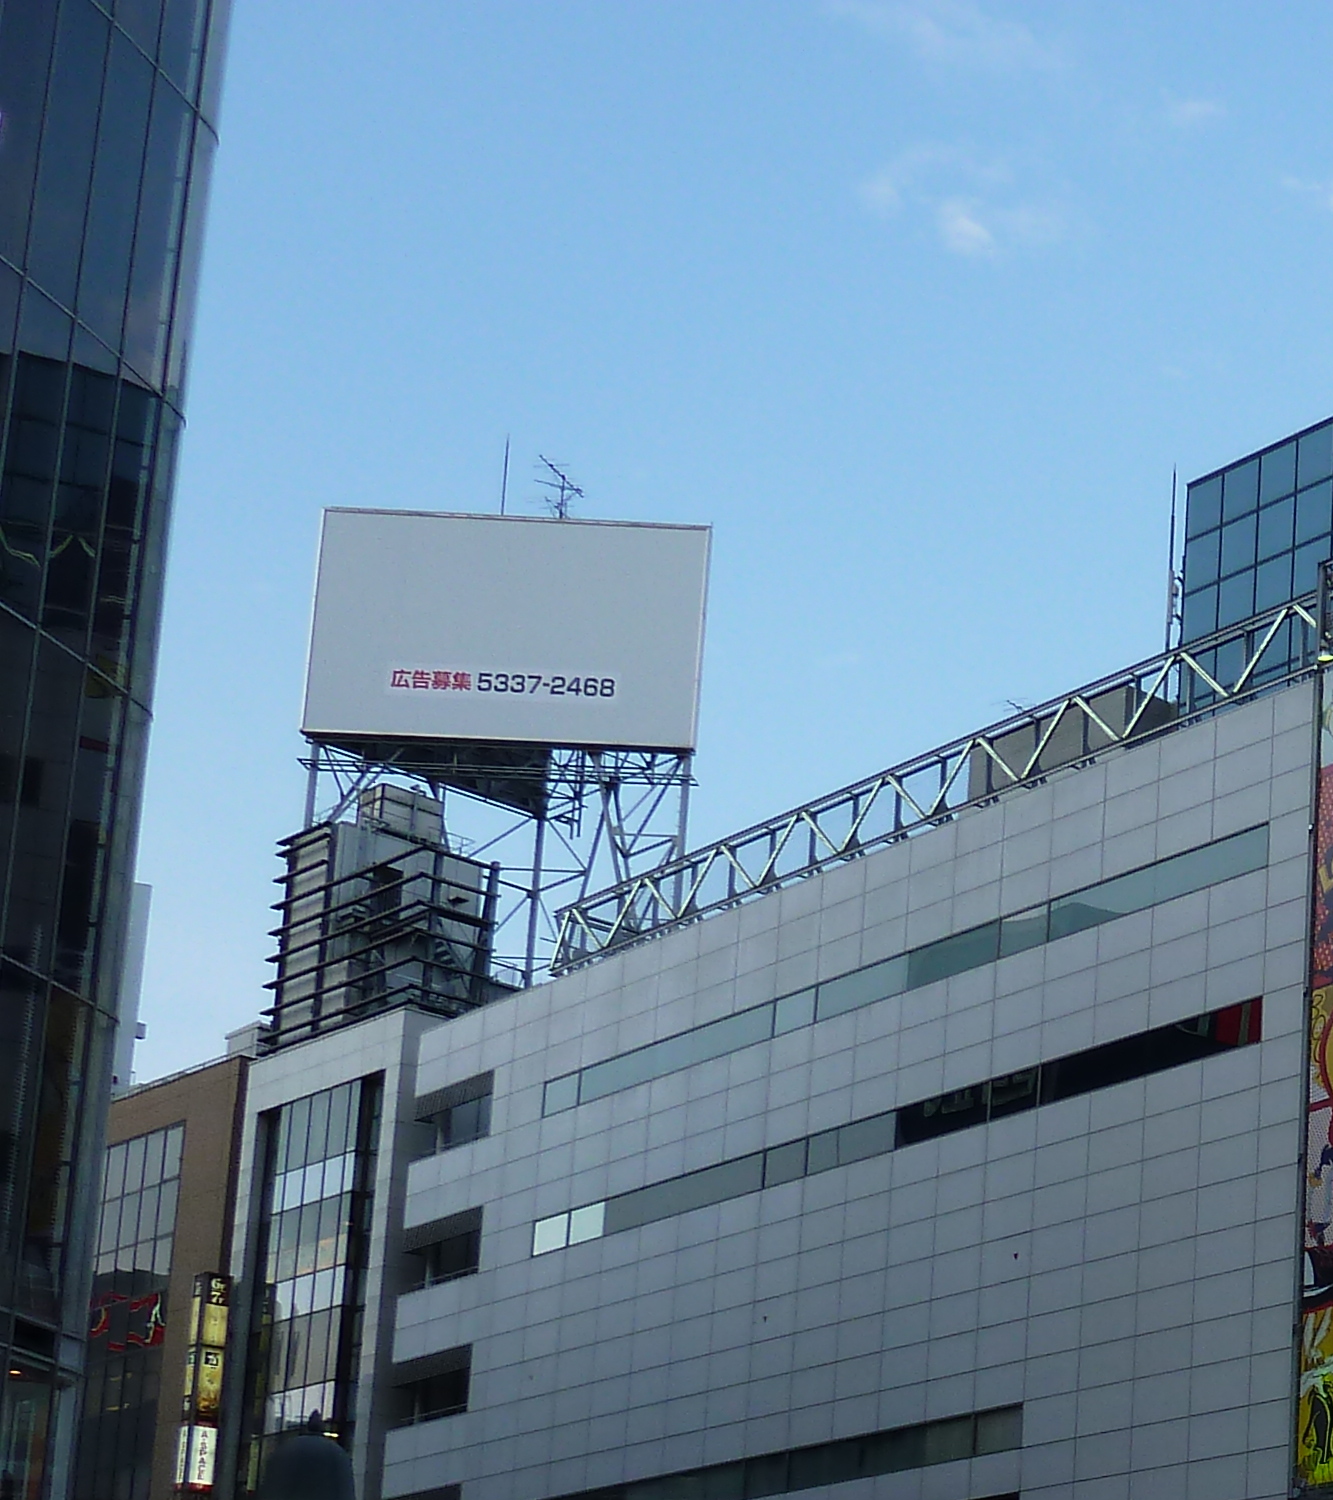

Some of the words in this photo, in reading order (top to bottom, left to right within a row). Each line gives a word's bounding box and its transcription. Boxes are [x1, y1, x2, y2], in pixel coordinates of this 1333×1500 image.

[390, 669, 472, 692] 広告募集
[476, 672, 616, 698] 5337-2468
